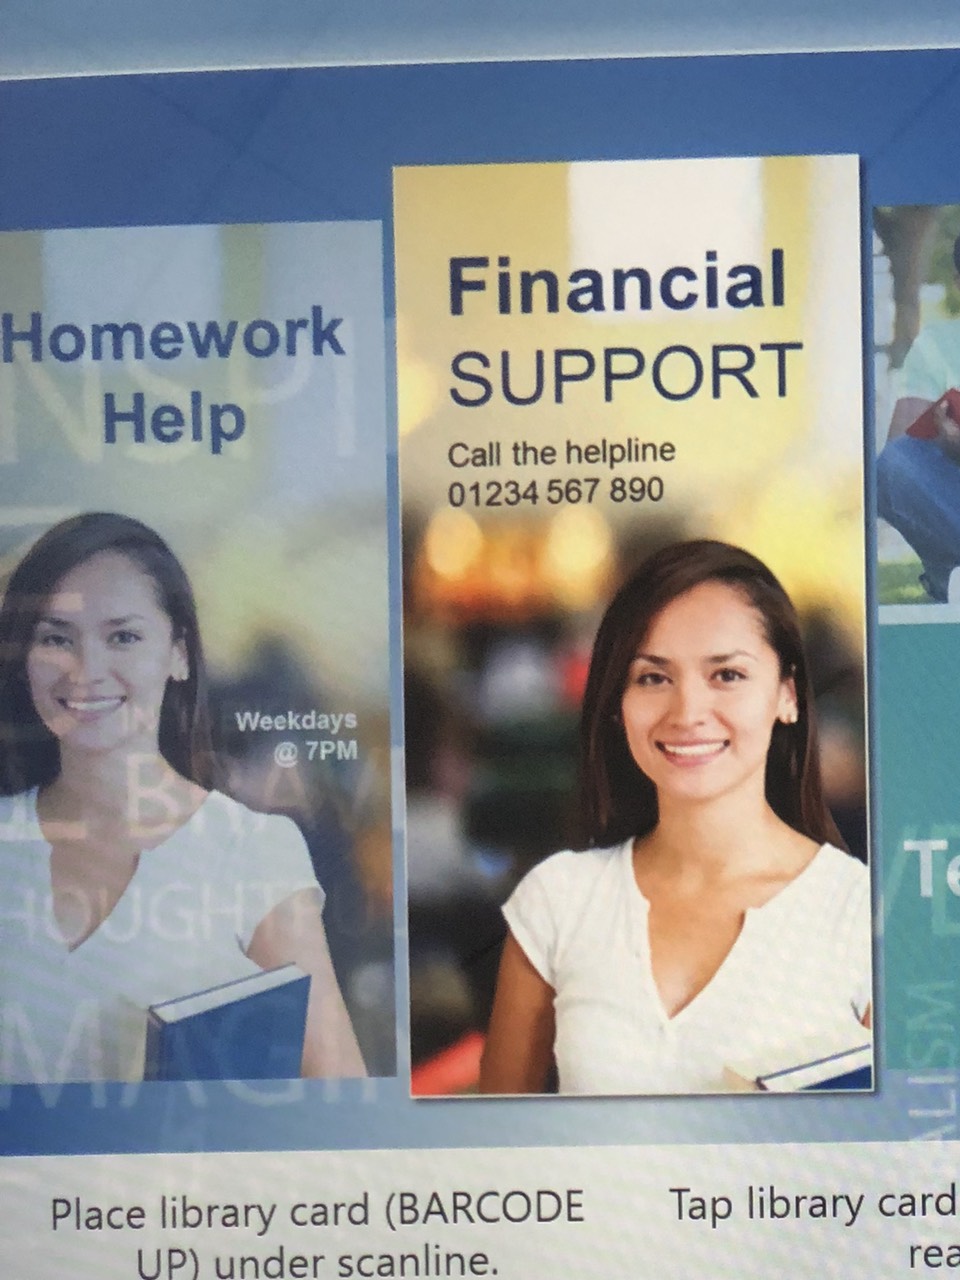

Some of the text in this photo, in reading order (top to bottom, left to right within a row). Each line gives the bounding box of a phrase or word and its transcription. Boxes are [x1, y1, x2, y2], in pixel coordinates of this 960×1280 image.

[449, 248, 785, 316] Financial
[1, 305, 346, 363] Homework
[450, 342, 804, 407] SUPPORT
[103, 391, 246, 455] Help
[448, 438, 676, 471] Call the helpline
[448, 476, 665, 507] 01234 567 890
[236, 710, 357, 736] Weekdays
[273, 739, 358, 768] @ 7PM
[50, 1189, 586, 1237] Place library card (BARCODE
[669, 1188, 734, 1229] Tap
[747, 1185, 865, 1227] library
[877, 1182, 957, 1218] card
[214, 1245, 326, 1280] under
[337, 1243, 500, 1278] scanline.
